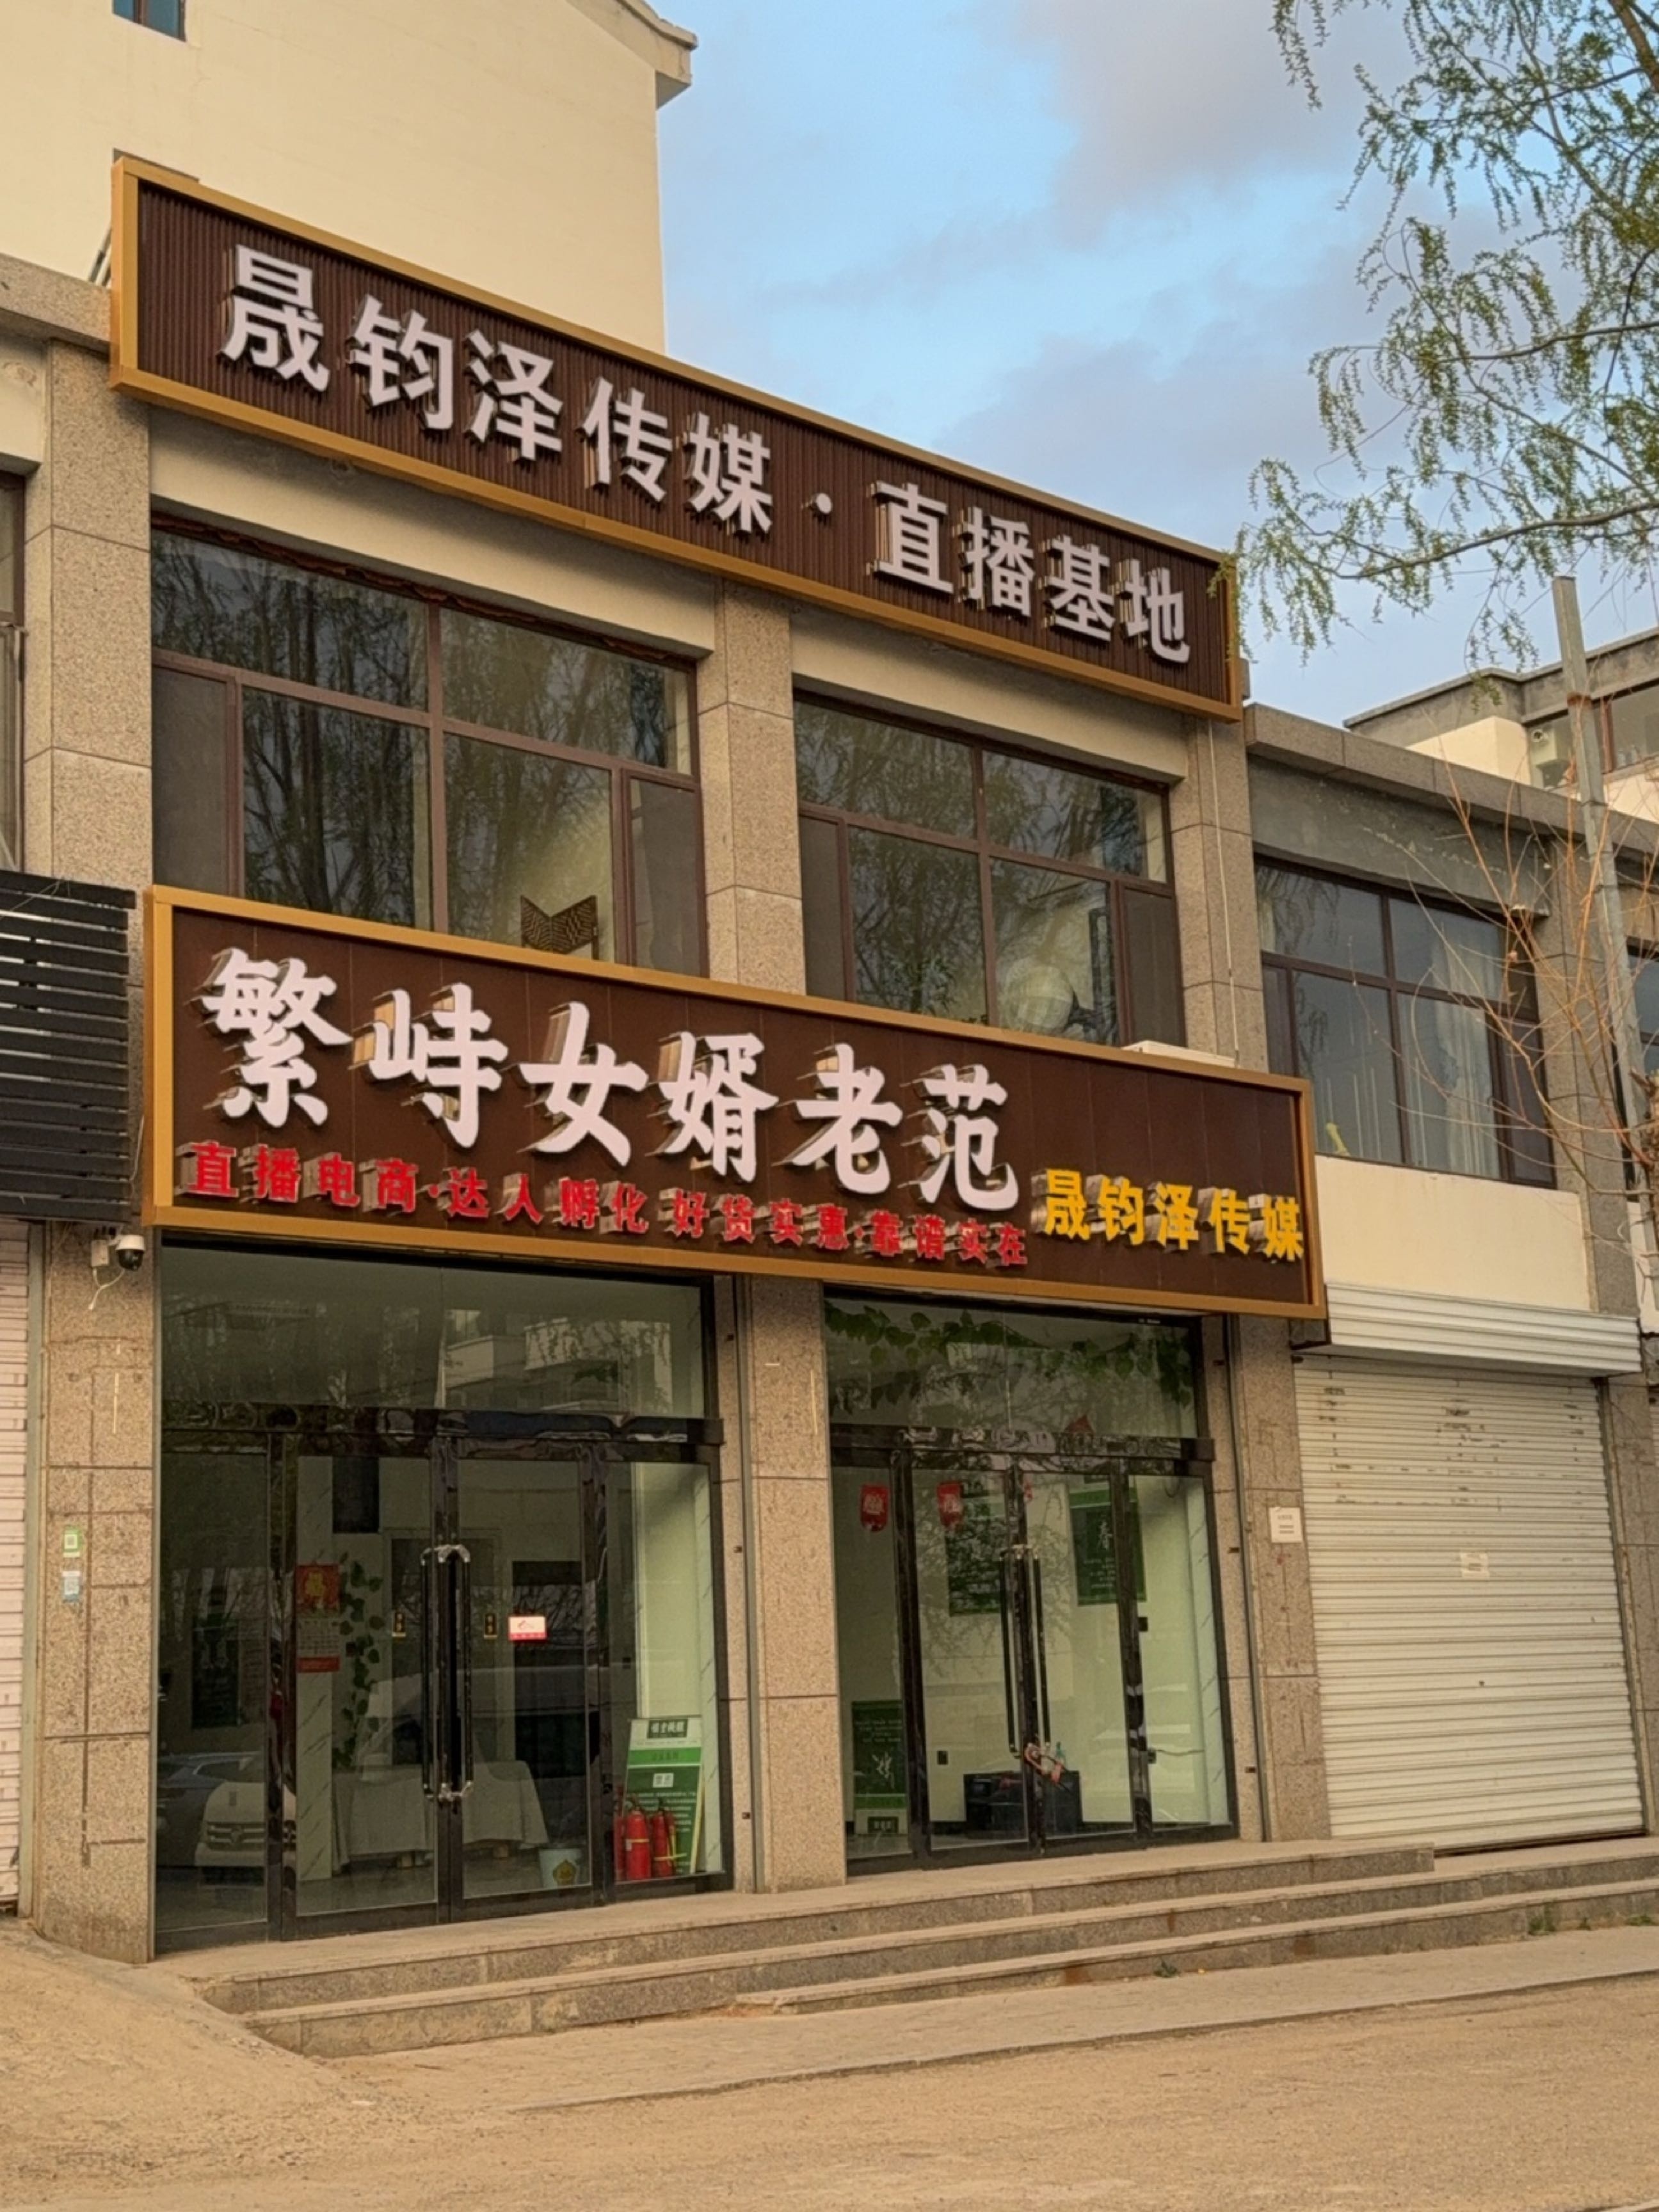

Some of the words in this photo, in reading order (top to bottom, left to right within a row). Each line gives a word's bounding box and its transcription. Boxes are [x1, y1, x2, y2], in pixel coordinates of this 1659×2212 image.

[201, 947, 1019, 1211] 繁峙女婿老范
[1043, 1168, 1304, 1262] 晟钧泽传媒
